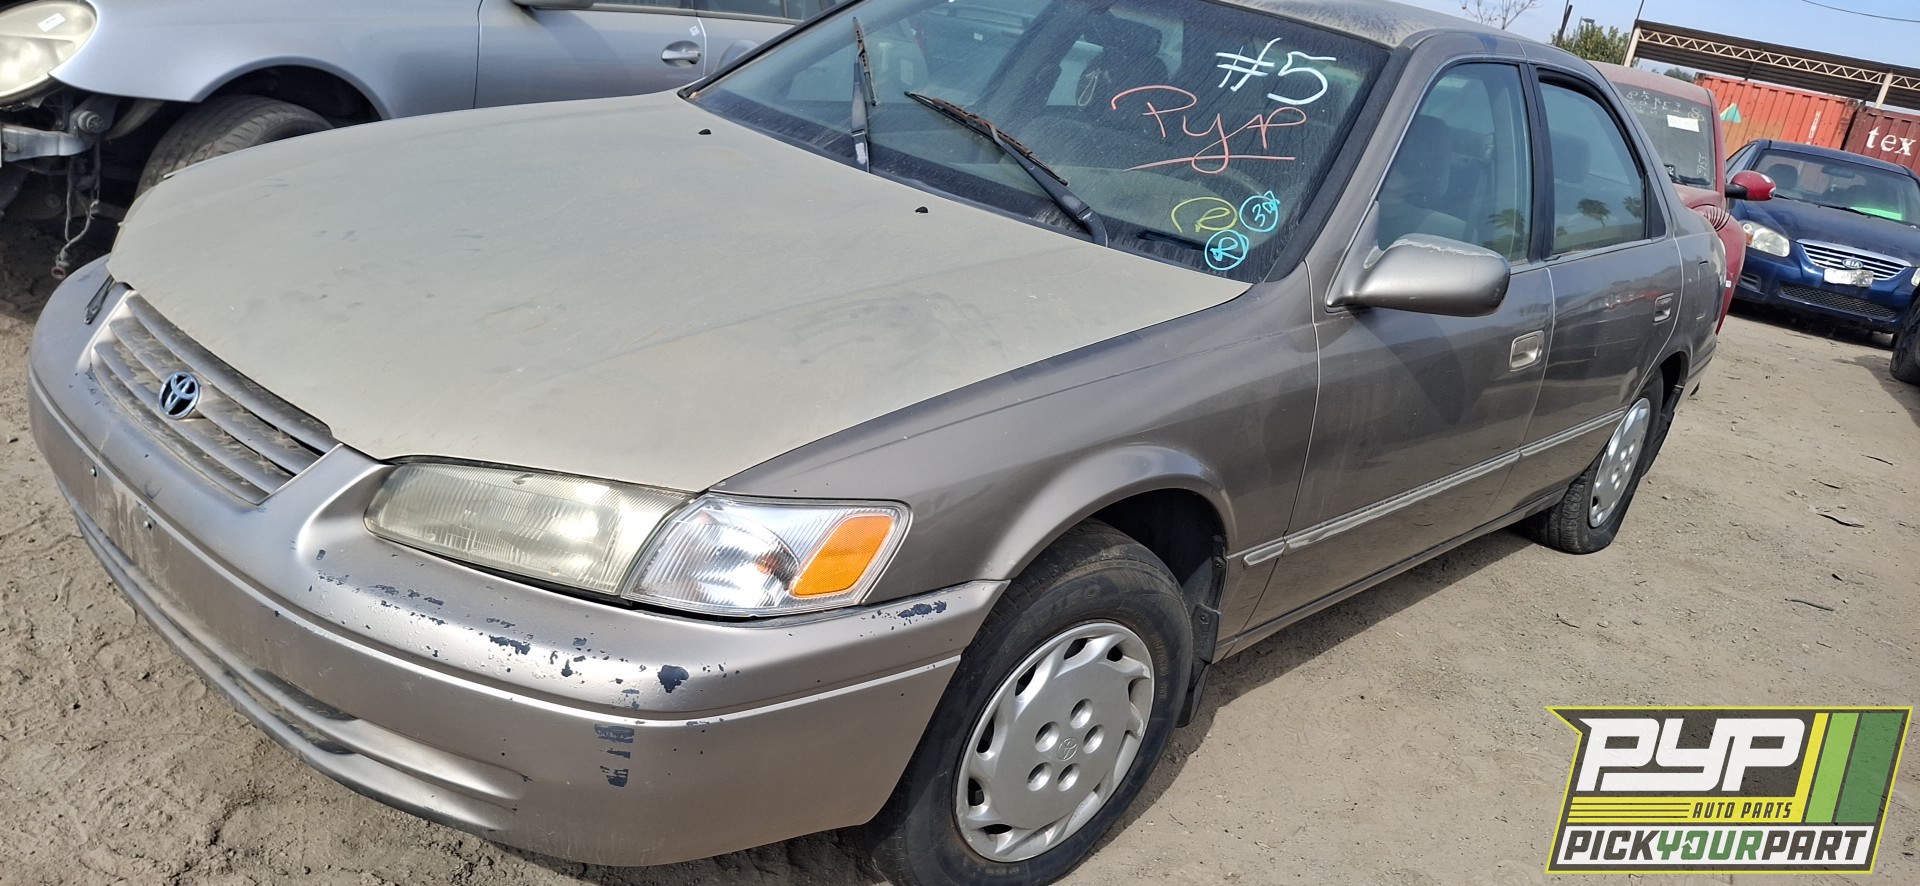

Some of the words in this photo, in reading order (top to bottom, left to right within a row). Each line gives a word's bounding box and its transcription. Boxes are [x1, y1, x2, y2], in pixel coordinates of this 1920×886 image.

[1215, 37, 1337, 105] #5
[1866, 126, 1917, 157] tex
[1844, 259, 1861, 269] KIA
